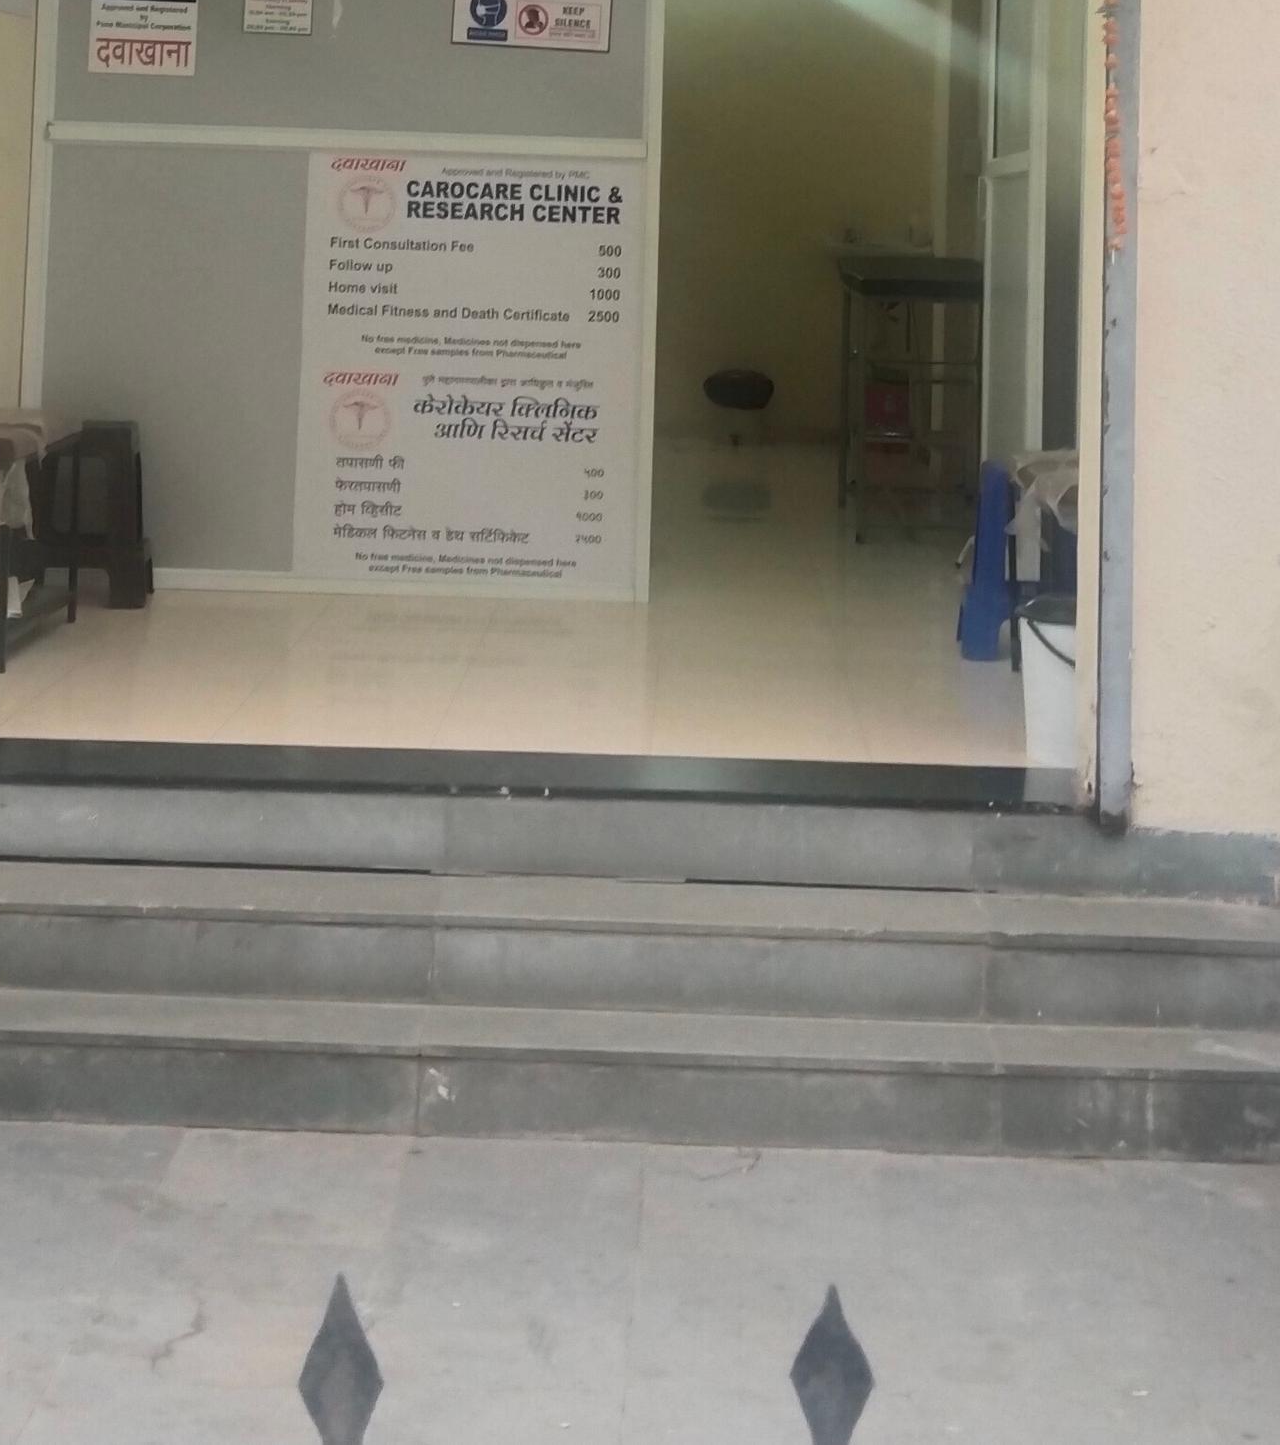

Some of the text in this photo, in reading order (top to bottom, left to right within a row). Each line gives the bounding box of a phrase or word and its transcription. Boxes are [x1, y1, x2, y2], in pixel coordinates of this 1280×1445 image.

[96, 38, 192, 67] दवाखाना
[330, 157, 407, 172] दवाखाना
[406, 180, 623, 203] CAROCARE CLINIC &
[406, 201, 620, 225] RESEARCH CENTER
[330, 236, 622, 257] First Consultation Fee 500
[329, 259, 621, 279] Follow up 300
[328, 282, 620, 301] Home visit 1000
[327, 303, 620, 323] Medical Fitness and Death Certificate 2500
[322, 371, 400, 387] दवाखाना
[413, 393, 600, 420] केरोकेयर क्लिनिक
[434, 417, 486, 440] आणि
